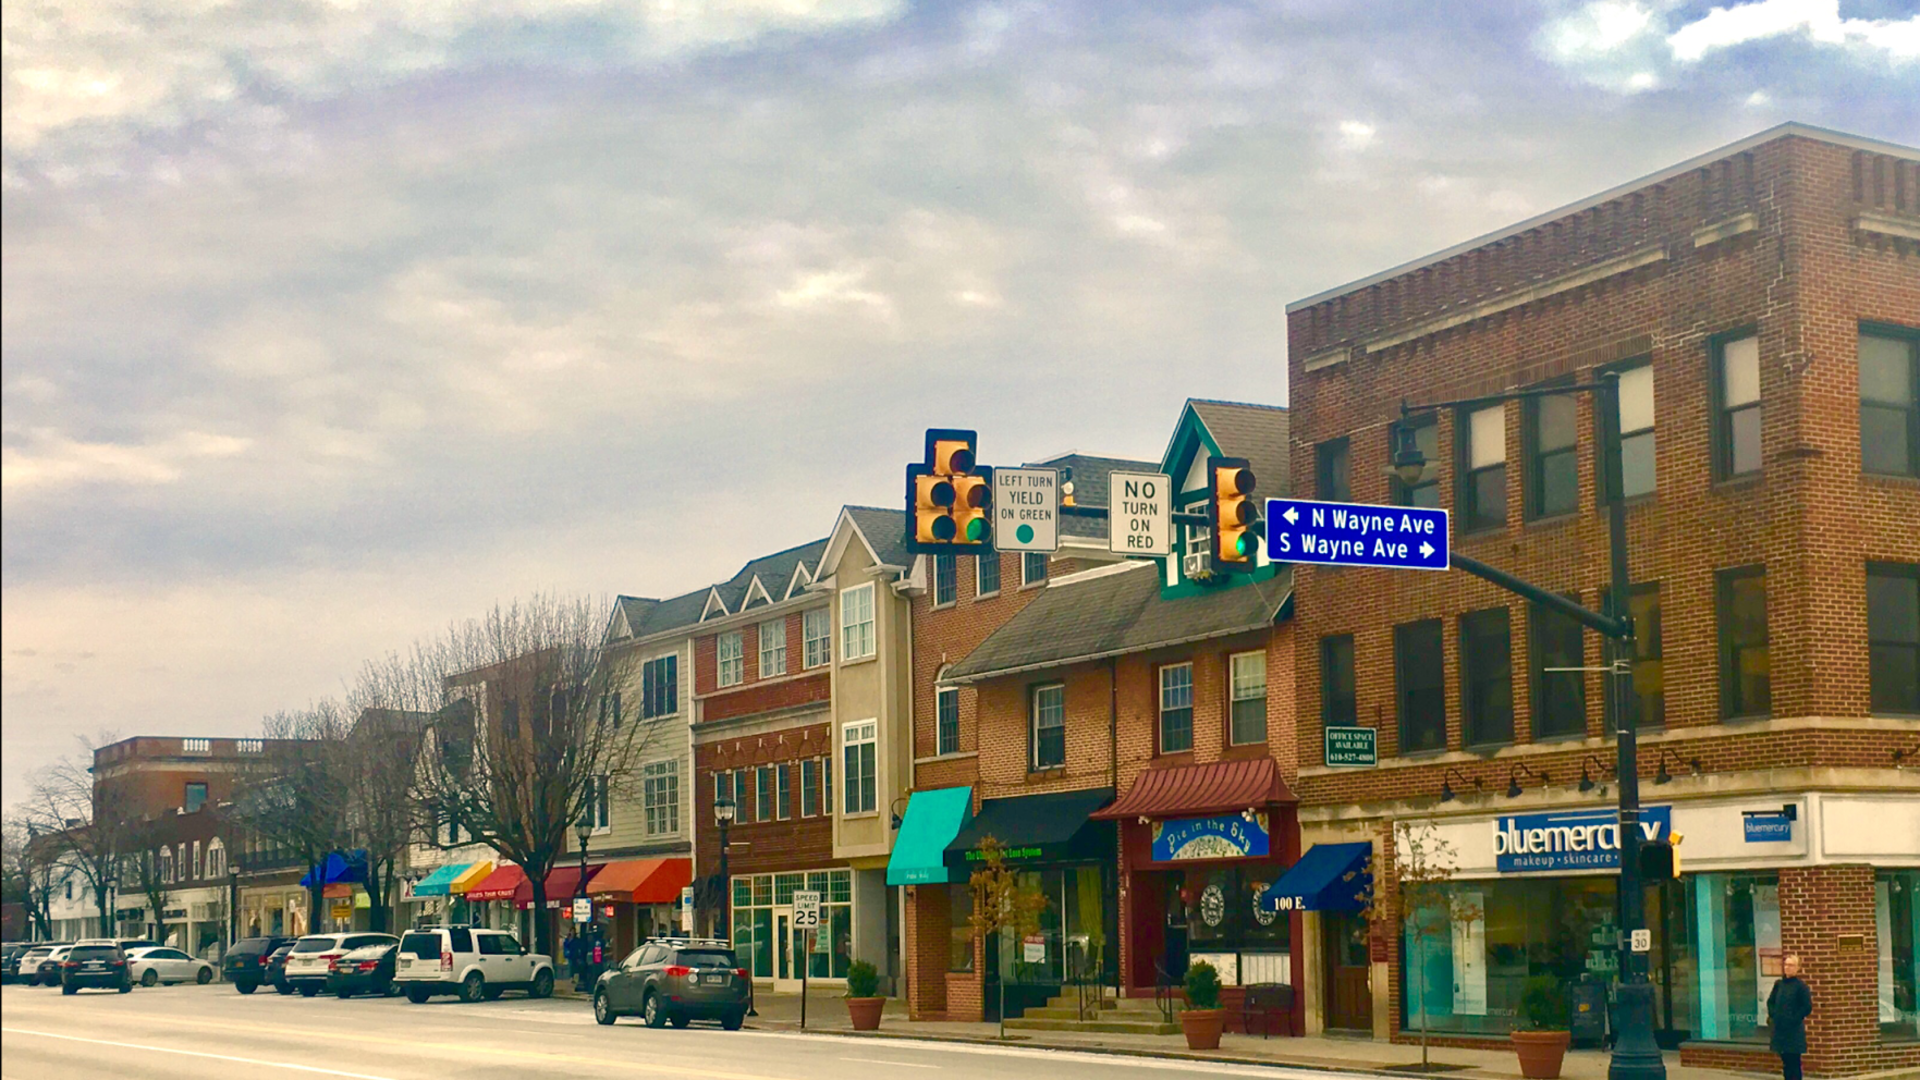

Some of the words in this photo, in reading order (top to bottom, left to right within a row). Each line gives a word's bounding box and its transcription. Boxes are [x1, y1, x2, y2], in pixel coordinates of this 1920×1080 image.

[1000, 475, 1023, 487] LEFT
[1027, 476, 1053, 488] TURN
[1125, 480, 1155, 499] NO
[1009, 491, 1043, 505] YIELD
[1001, 508, 1014, 520] ON
[1019, 509, 1051, 520] GREEN
[1122, 501, 1158, 516] TURN
[1130, 518, 1150, 532] ON
[1312, 508, 1325, 527] N
[1332, 509, 1394, 536] Wayne
[1399, 514, 1435, 534] Ave
[1127, 535, 1154, 549] RED
[1280, 532, 1291, 552] S
[1301, 534, 1364, 560] Wayne
[1372, 538, 1408, 559] Ave
[1330, 732, 1352, 740] OFFICE
[1353, 733, 1373, 741] SPACE
[1335, 741, 1369, 750] AVAILABLE
[1746, 821, 1790, 834] bluemercury
[1167, 829, 1187, 854] Pie
[1191, 822, 1202, 833] in
[1207, 819, 1225, 832] the
[1230, 821, 1251, 853] Sky
[1514, 855, 1554, 868] makeup
[1563, 853, 1612, 866] skincare
[795, 894, 819, 902] SPEED
[1274, 896, 1293, 910] 100
[1295, 896, 1306, 910] E.
[795, 910, 818, 925] 25
[1635, 938, 1647, 948] 30
